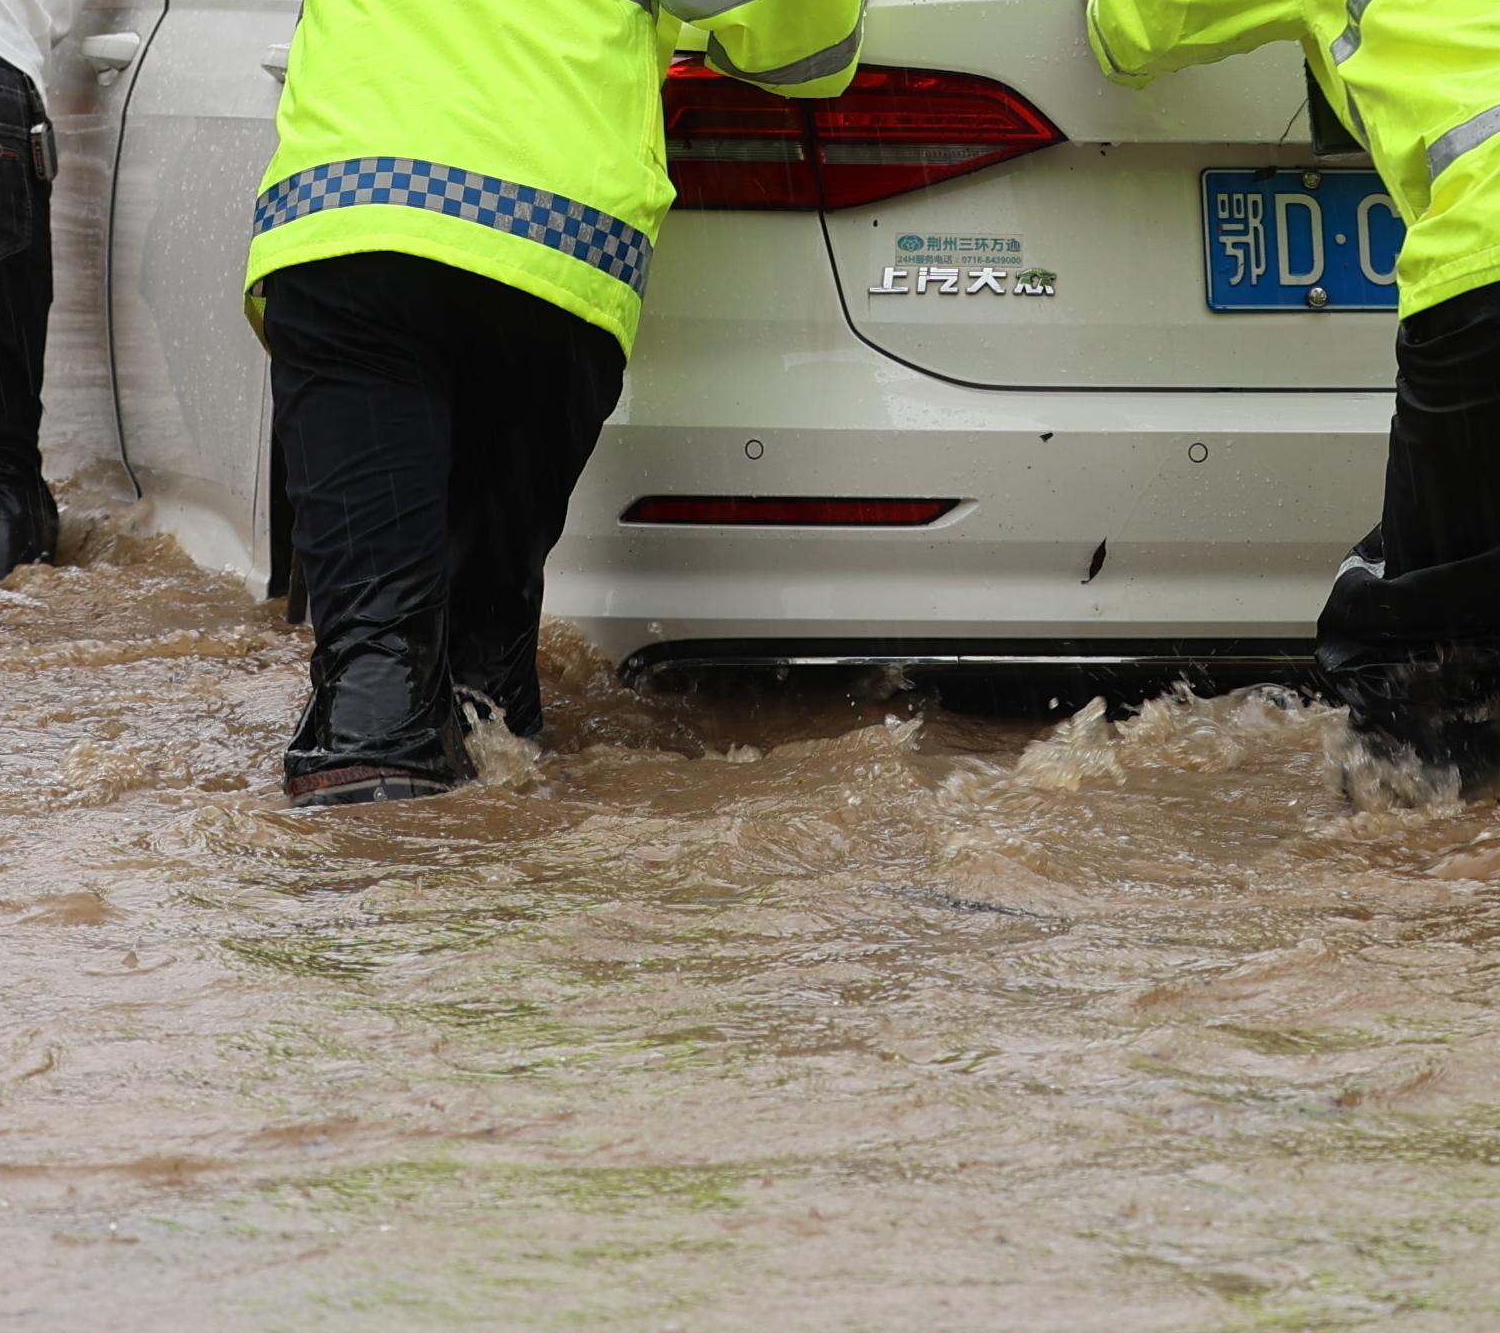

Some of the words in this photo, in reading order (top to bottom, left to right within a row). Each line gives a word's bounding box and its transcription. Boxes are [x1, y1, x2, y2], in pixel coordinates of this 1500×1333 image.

[926, 236, 1021, 252] 荆州三环万通
